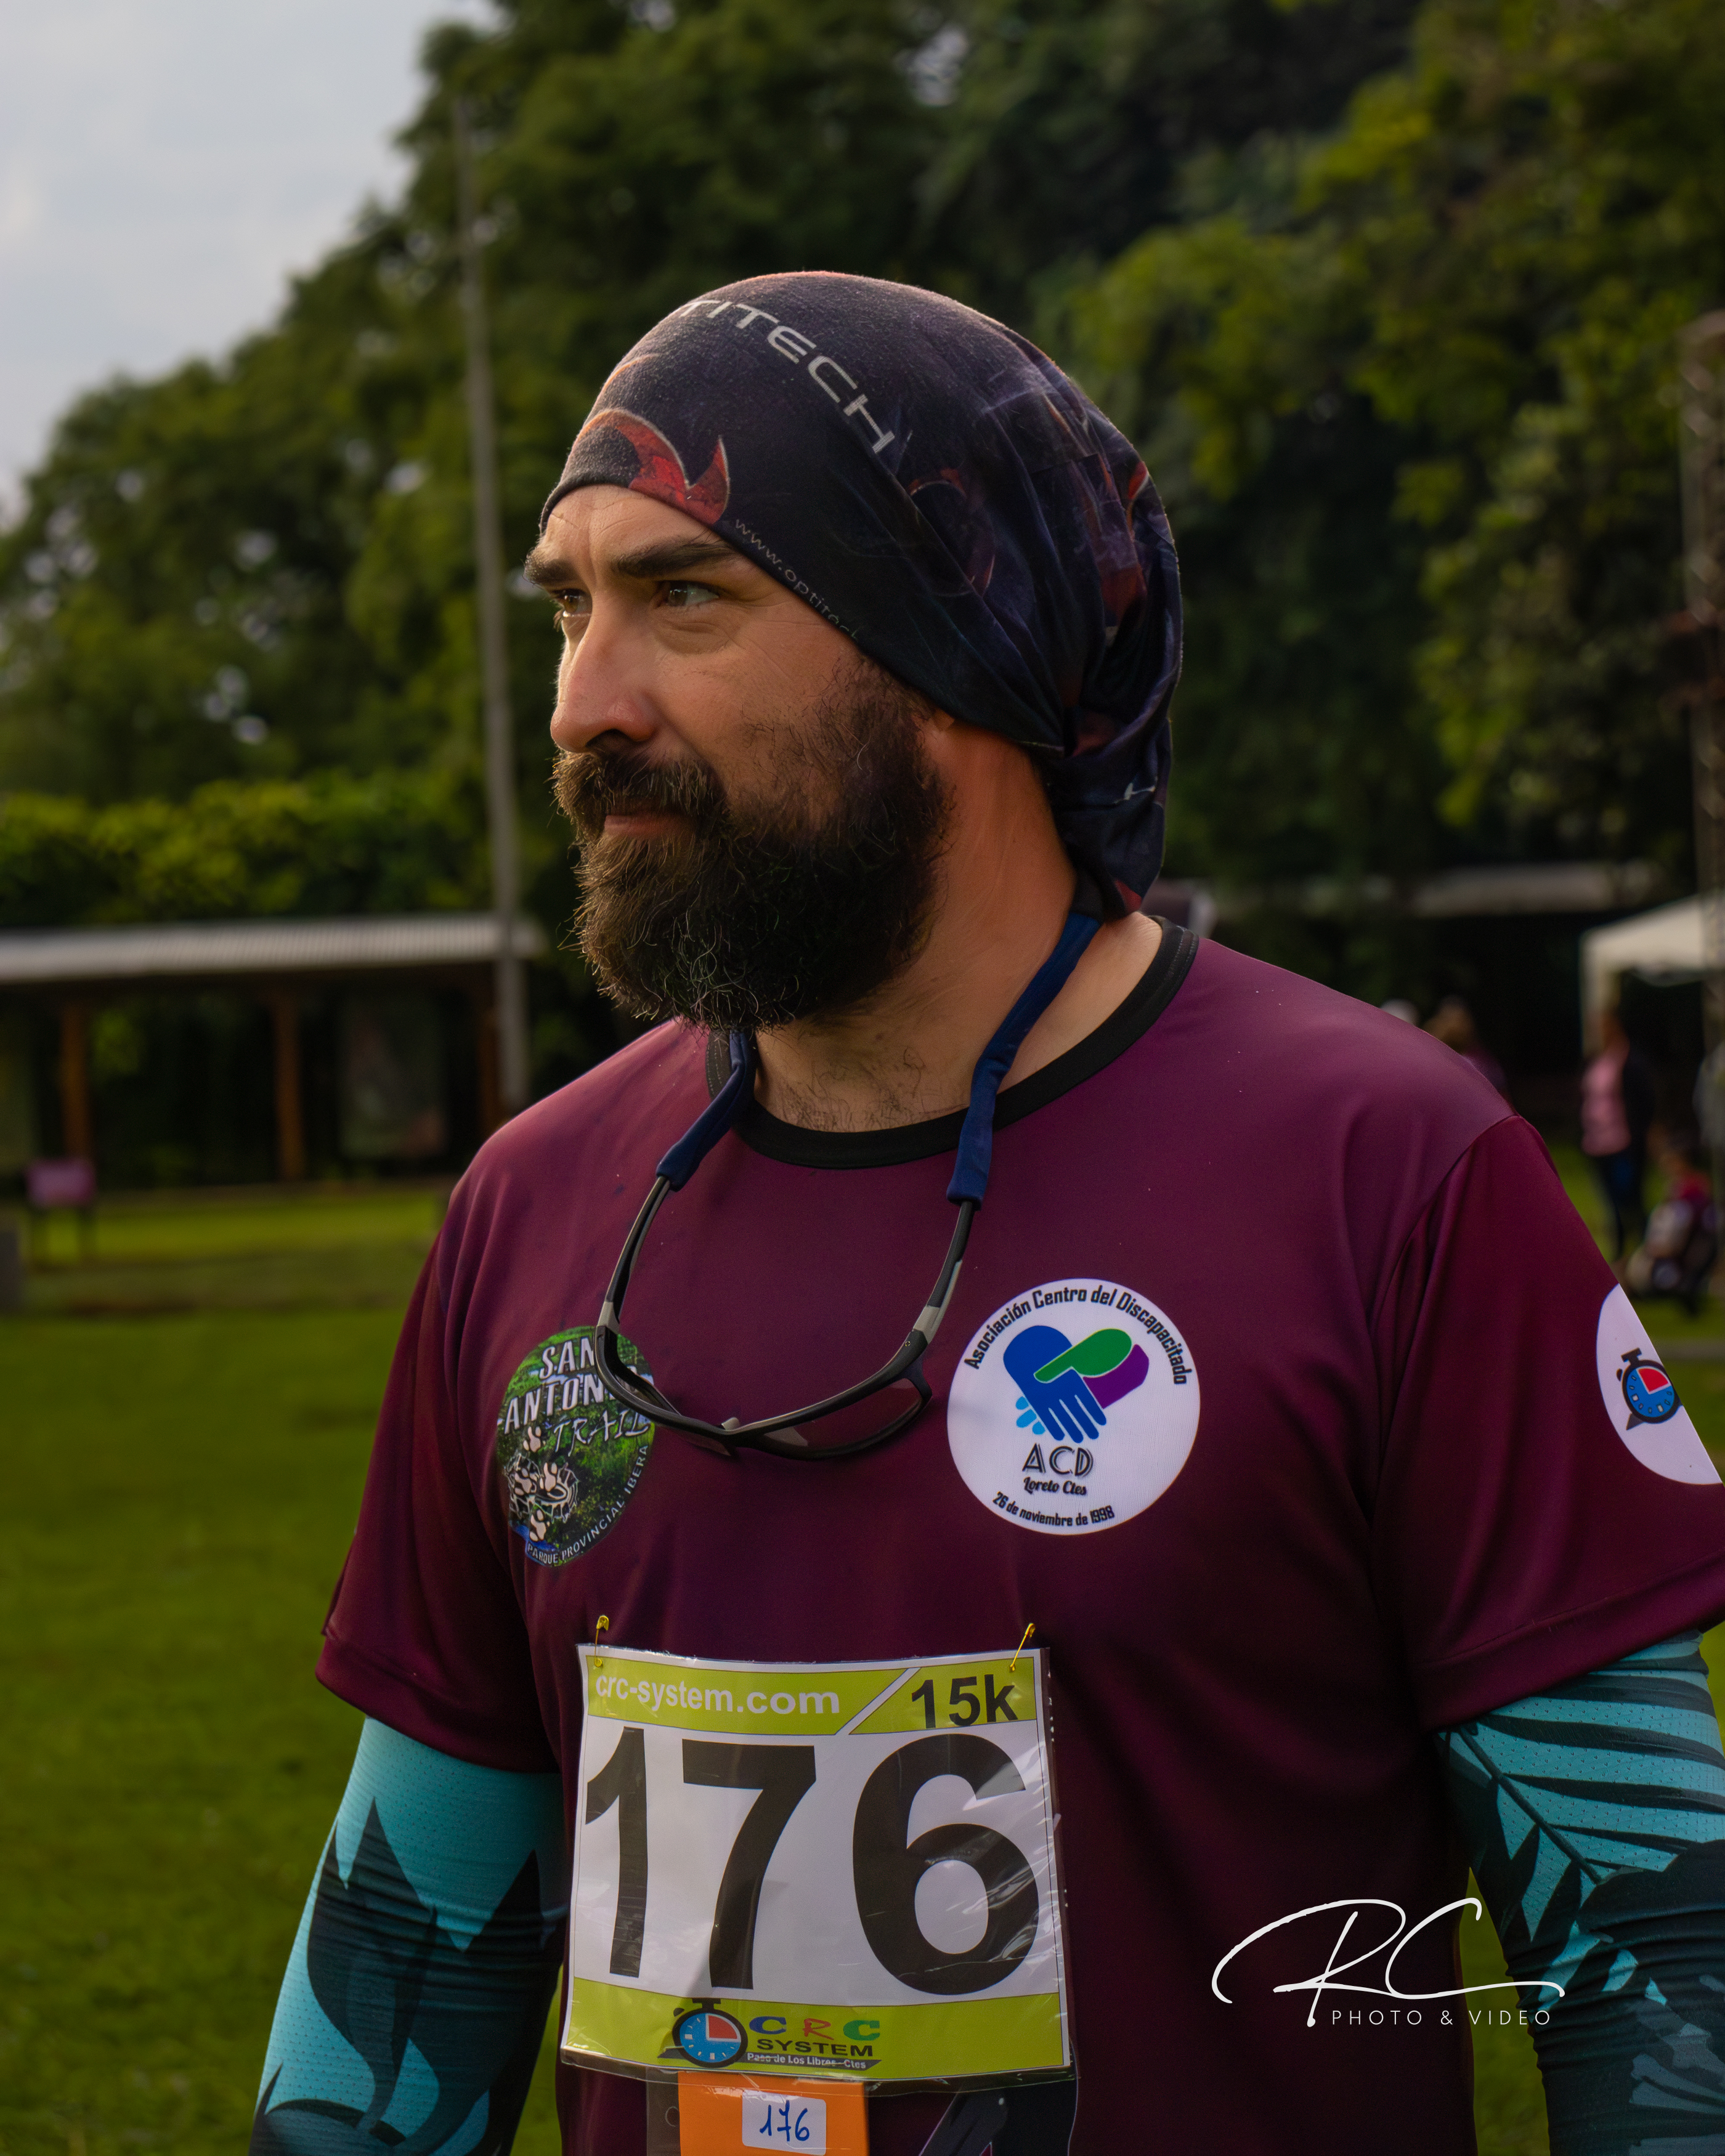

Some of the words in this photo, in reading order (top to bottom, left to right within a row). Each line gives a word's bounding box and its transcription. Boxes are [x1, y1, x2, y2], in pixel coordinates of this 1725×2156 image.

[964, 1299, 1031, 1369] Asociación
[1032, 1287, 1086, 1309] Centro
[1090, 1284, 1118, 1305] del
[1116, 1291, 1192, 1385] Discapacitado
[539, 1337, 595, 1380] SAN
[504, 1364, 638, 1435] ANTON
[553, 1409, 651, 1457] TRAIL
[1022, 1443, 1094, 1477] ACD
[527, 1542, 559, 1564] PARQUE
[561, 1499, 625, 1561] PROVINCIAL
[623, 1445, 649, 1494] IBERA
[1023, 1476, 1060, 1495] Loreto
[992, 1491, 1009, 1509] 26
[1005, 1501, 1019, 1515] de
[1019, 1508, 1073, 1526] noviembre
[1075, 1512, 1089, 1526] de
[1089, 1505, 1115, 1524] 1998
[595, 1672, 841, 1716] crc-system.com
[911, 1672, 1018, 1730] 15k
[585, 1725, 1039, 1996] 176
[757, 2038, 874, 2057] SYSTEM
[773, 2054, 785, 2063] de
[787, 2055, 805, 2065] Los
[759, 2099, 810, 2142] 176
